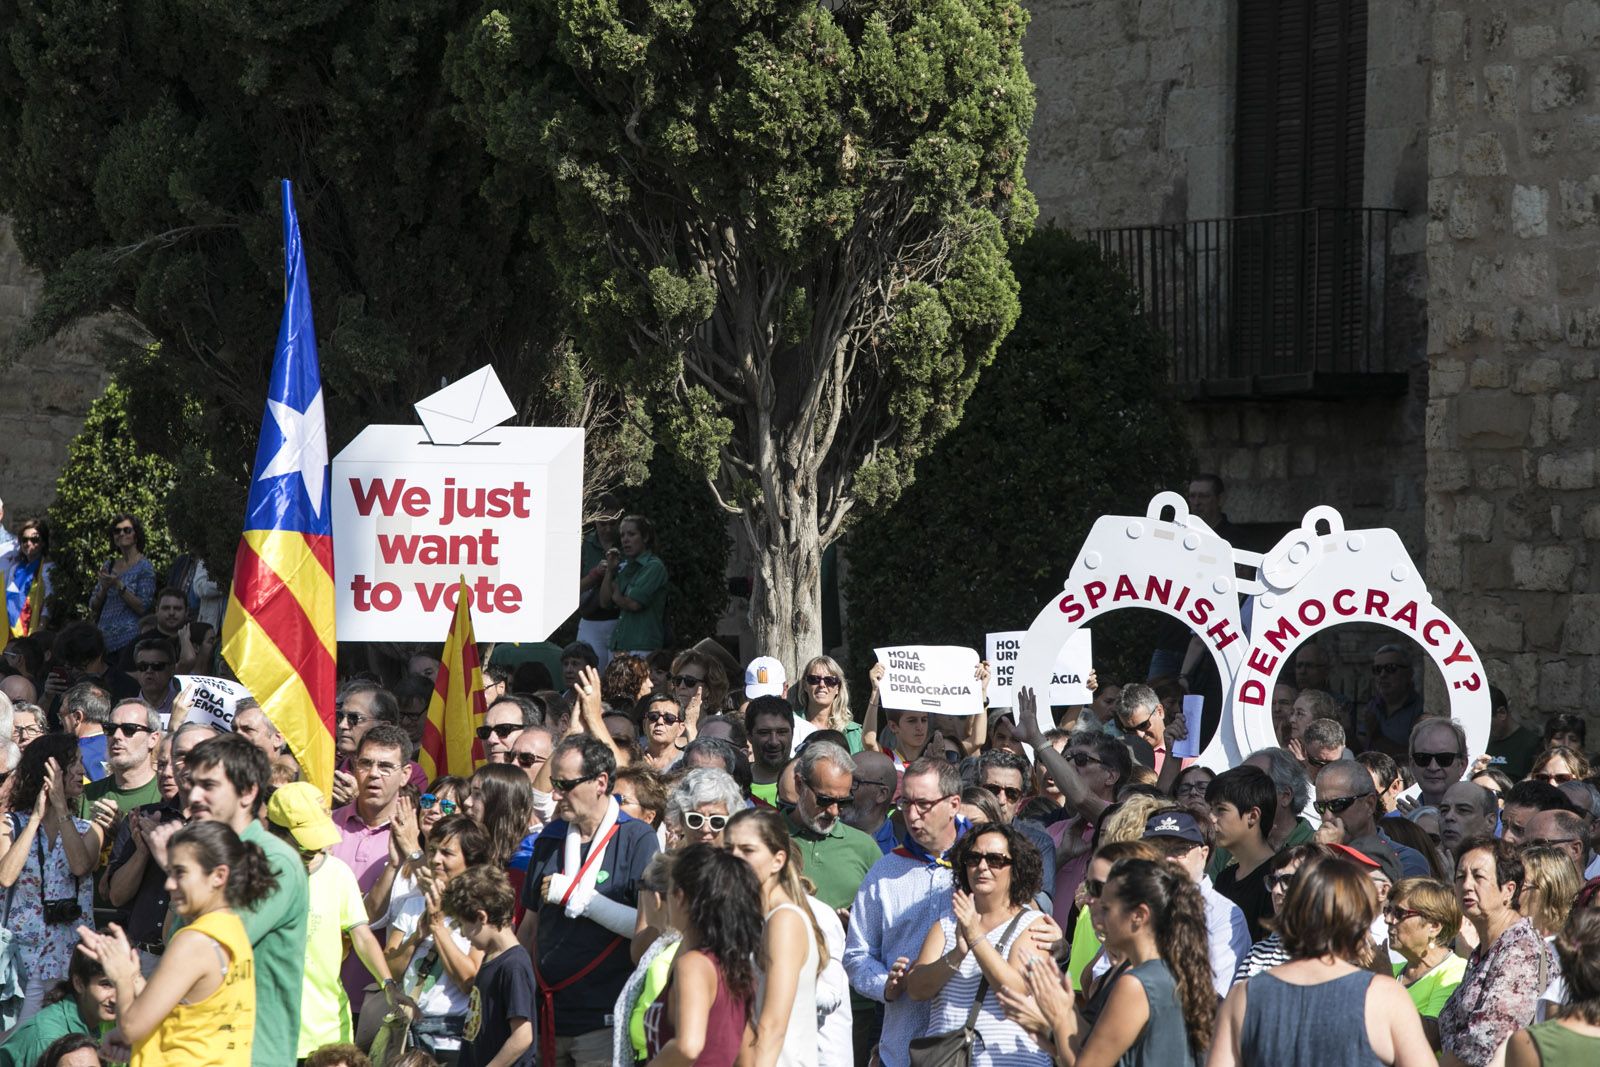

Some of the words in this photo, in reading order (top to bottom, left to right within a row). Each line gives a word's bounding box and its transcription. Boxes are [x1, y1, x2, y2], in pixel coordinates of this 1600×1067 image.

[349, 478, 431, 517] We
[439, 478, 531, 526] just
[377, 528, 500, 566] want
[351, 574, 403, 613] to
[414, 576, 523, 614] vote
[1059, 574, 1239, 651] SPANISH
[887, 650, 920, 661] HOLA
[996, 640, 1021, 650] HOL
[1238, 588, 1482, 707] DEMOCRACY?
[889, 659, 926, 672] URNES
[889, 673, 922, 684] HOLA
[890, 683, 971, 696] DEMOCRÀCIA
